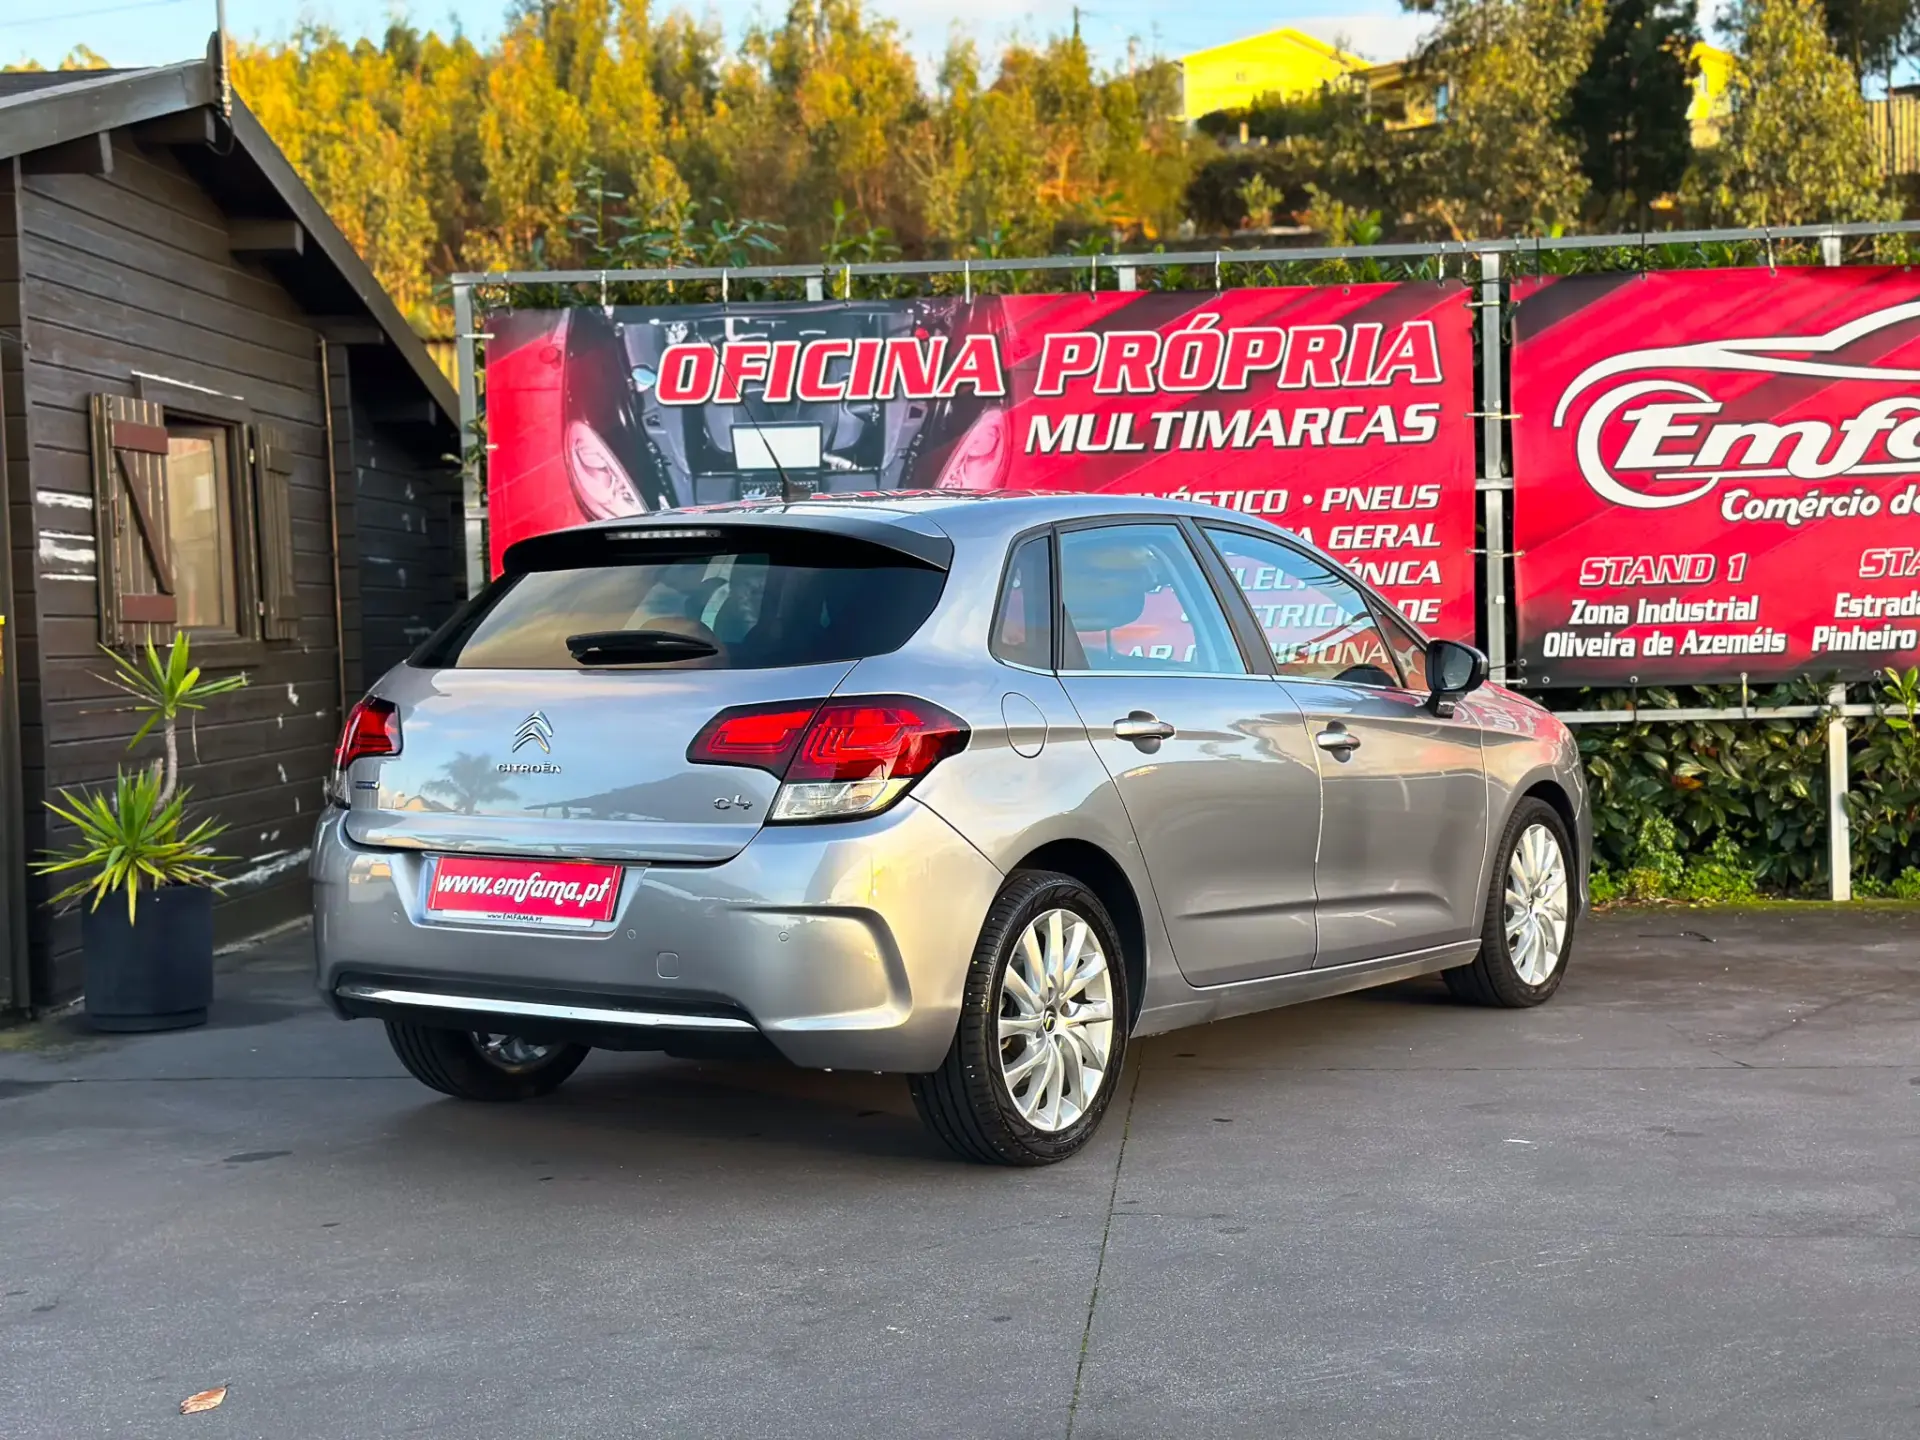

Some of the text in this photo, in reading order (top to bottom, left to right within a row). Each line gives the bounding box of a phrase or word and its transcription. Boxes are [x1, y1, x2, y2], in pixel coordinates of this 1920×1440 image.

[656, 313, 1443, 403] OFICINA PRÓPRIA
[1025, 403, 1440, 453] MULTIMARCAS
[1321, 484, 1441, 512] PNEUS
[1722, 489, 1881, 525] Comércio
[1328, 523, 1441, 549] GERAL
[1579, 553, 1748, 586] STAND 1
[1569, 596, 1759, 625] Zona Industrial
[1834, 590, 1920, 618] Estrad
[1543, 627, 1786, 657] Oliveira de Azeméis
[1811, 623, 1918, 652] Pinheiro
[496, 761, 562, 774] CITROËN
[713, 794, 753, 811] C4
[437, 872, 611, 908] www.emfama.pt
